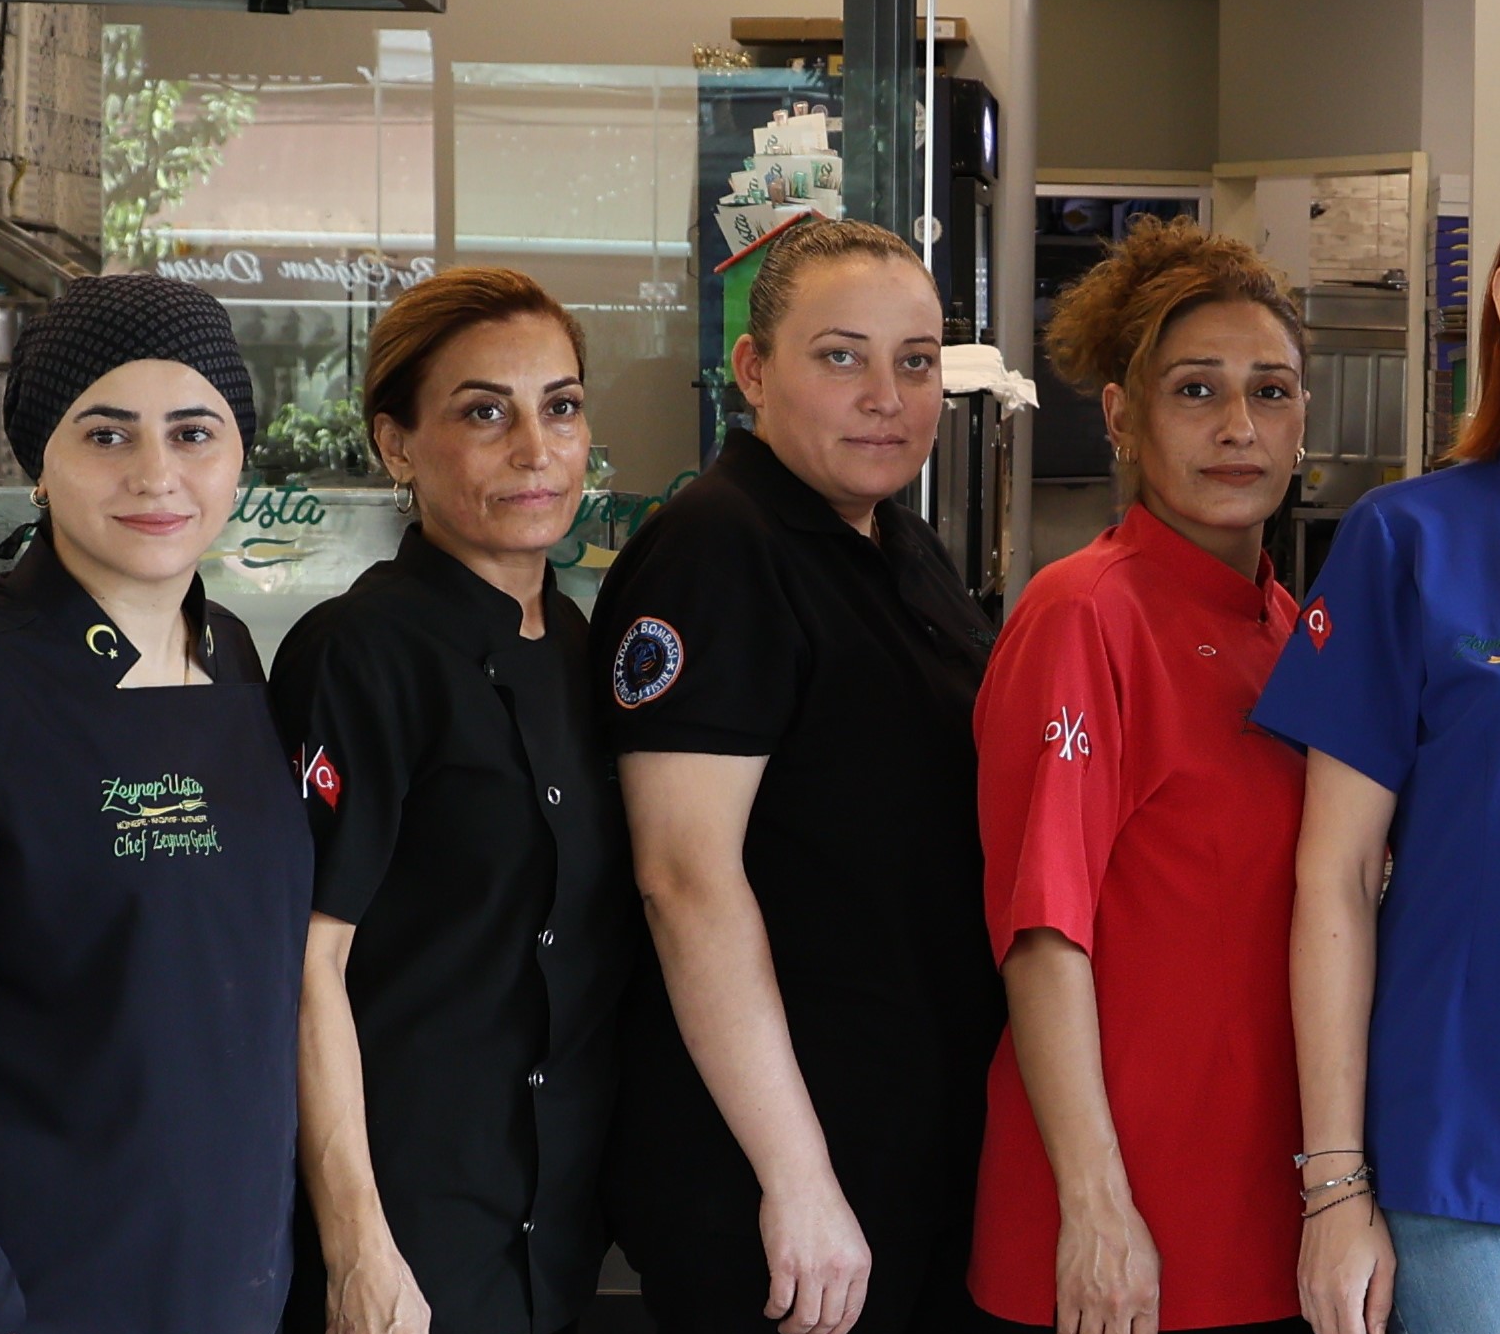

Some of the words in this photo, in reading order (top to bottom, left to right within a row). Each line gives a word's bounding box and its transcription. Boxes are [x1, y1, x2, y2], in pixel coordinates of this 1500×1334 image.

[101, 777, 167, 816] Zeynep
[163, 773, 204, 797] Usta
[114, 829, 147, 862] Chef
[152, 830, 191, 857] Zeynep
